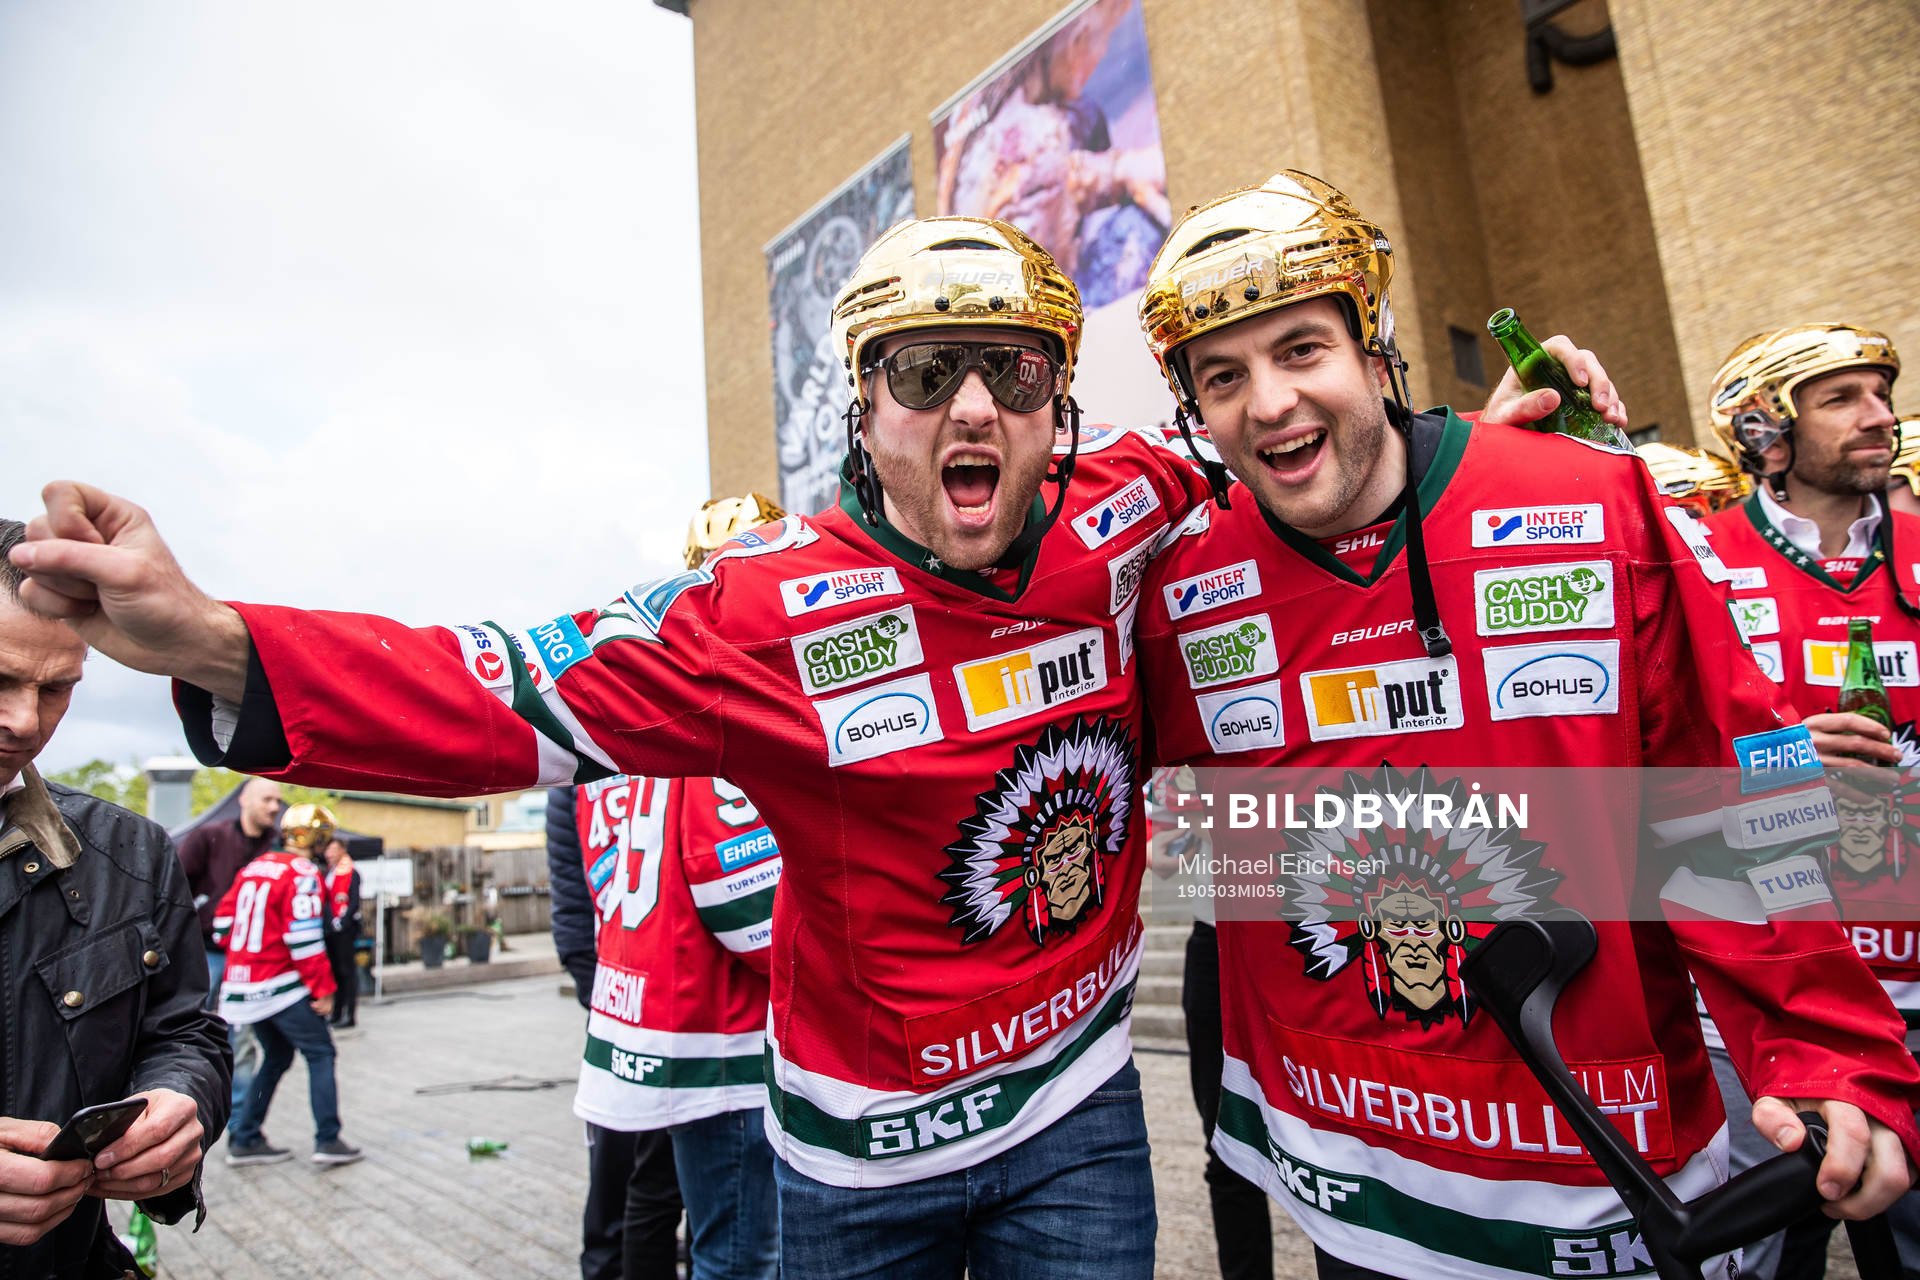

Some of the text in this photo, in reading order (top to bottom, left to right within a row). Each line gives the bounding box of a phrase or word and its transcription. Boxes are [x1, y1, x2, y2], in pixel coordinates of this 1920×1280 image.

[1181, 257, 1264, 298] BAUER
[1111, 485, 1146, 513] INTER
[1118, 497, 1152, 524] SPORT
[1527, 511, 1583, 526] INTER
[1335, 532, 1385, 555] SHL
[1526, 525, 1584, 540] SPORT
[831, 572, 881, 589] INTER
[835, 582, 885, 600] SPORT
[1199, 569, 1244, 592] INTER
[1202, 582, 1246, 605] SPORT
[1488, 578, 1563, 605] CASH
[1489, 599, 1584, 626] BUDDY
[535, 620, 574, 664] ORG
[1331, 619, 1414, 646] BAUER
[804, 628, 873, 666] CASH
[1186, 635, 1236, 661] CASH
[810, 644, 897, 688] BUDDY
[1190, 650, 1254, 681] BUDDY
[1513, 678, 1593, 698] BOHUS
[847, 712, 917, 742] BOHUS
[1220, 715, 1272, 737] BOHUS
[1750, 738, 1819, 777] EHREN
[1746, 801, 1830, 835] TURKISH
[723, 833, 777, 864] EHREN
[727, 870, 775, 893] TURKISH
[747, 929, 772, 943] TUR
[921, 915, 1138, 1077] SILVERBULL
[612, 1047, 663, 1081] SKF
[1570, 1065, 1656, 1104] ILM
[869, 1084, 1002, 1157] SKF
[1552, 1231, 1654, 1275] SK
